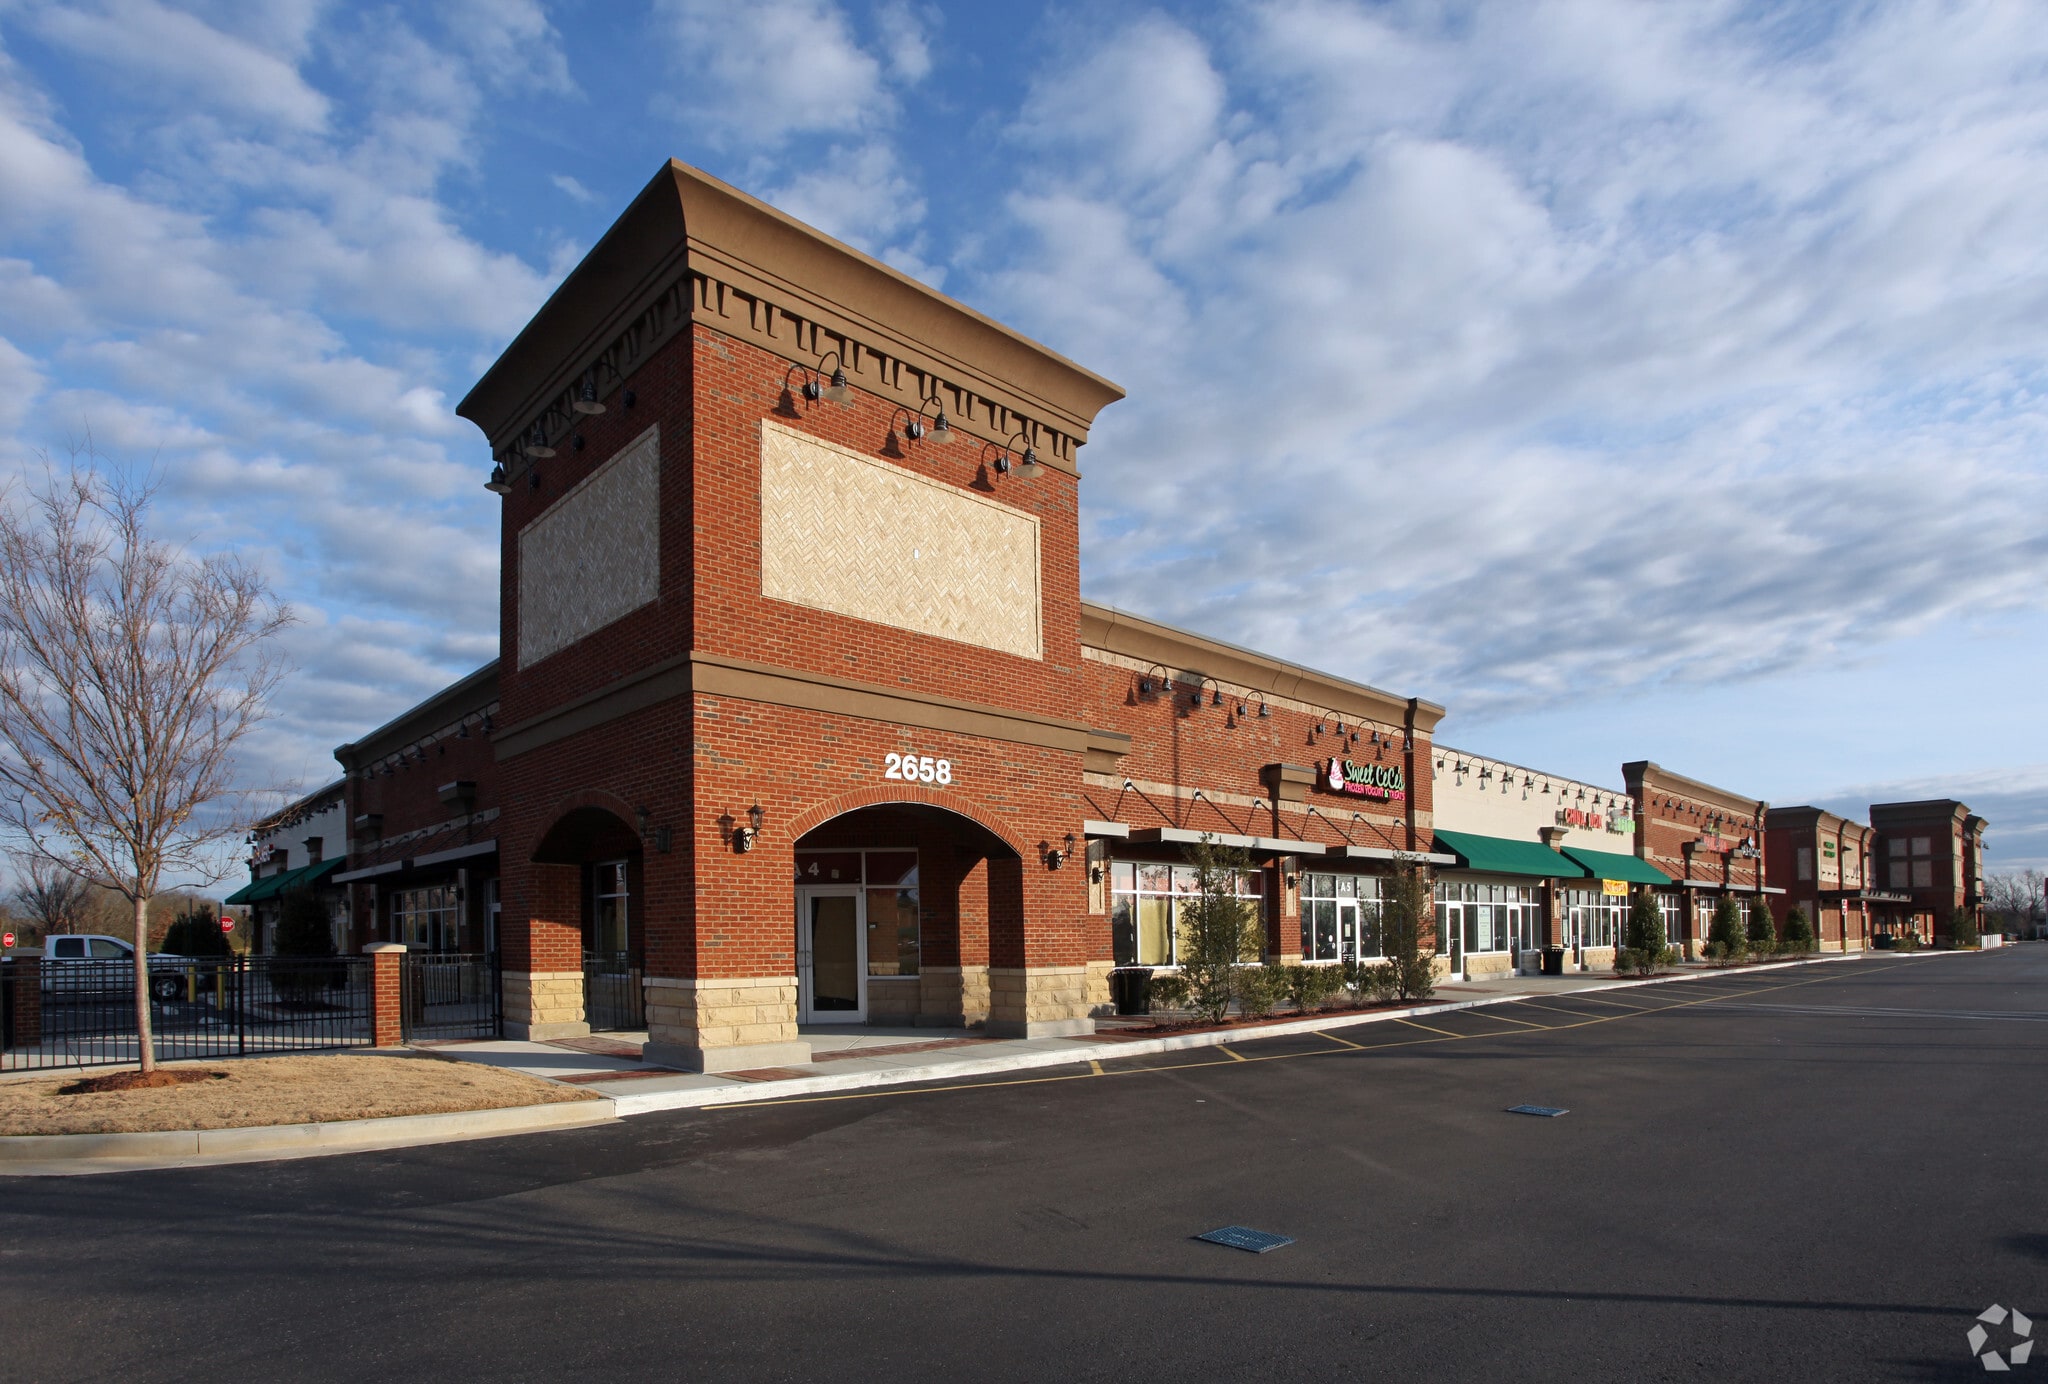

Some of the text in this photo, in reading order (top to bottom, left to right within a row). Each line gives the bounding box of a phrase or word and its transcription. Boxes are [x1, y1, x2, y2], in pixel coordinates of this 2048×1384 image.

[885, 753, 952, 785] 2658
[1344, 760, 1374, 785] Sweet
[1344, 781, 1365, 794] FROZEN
[1365, 784, 1384, 798] YOGURT
[1389, 789, 1405, 800] TREATS
